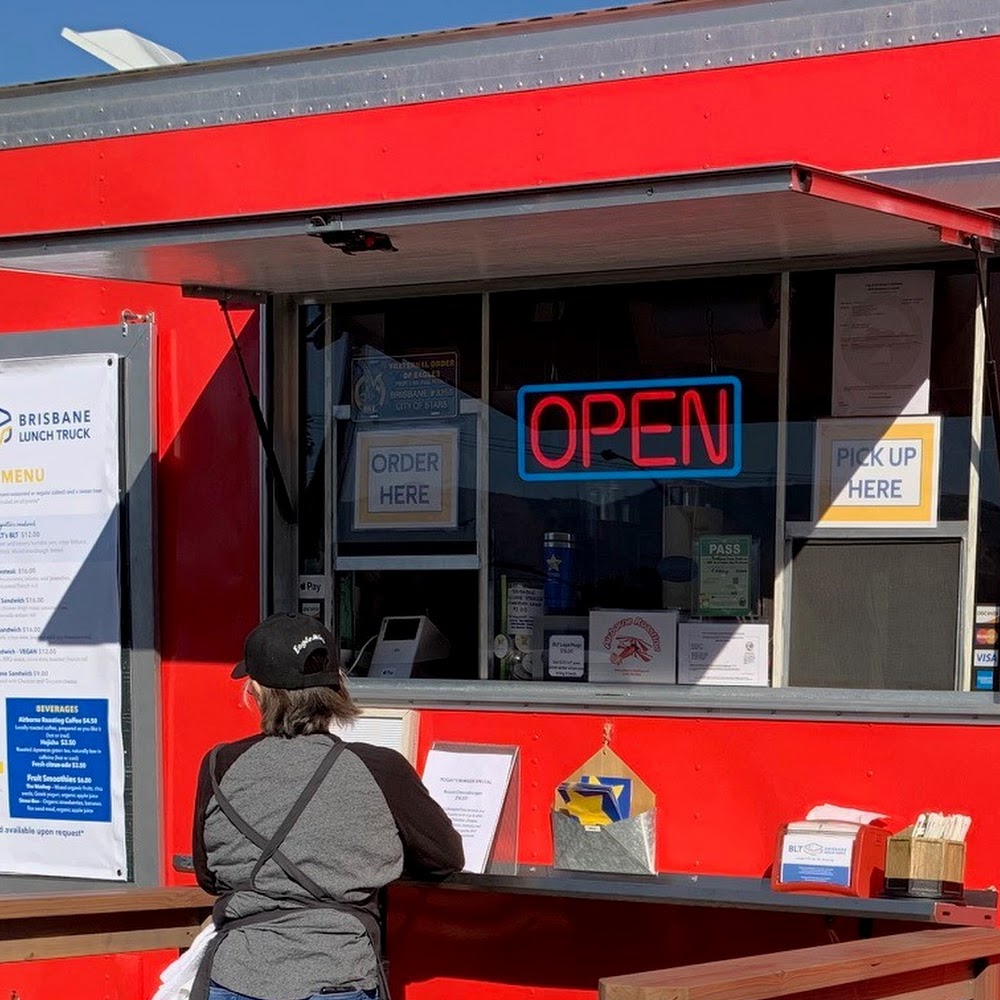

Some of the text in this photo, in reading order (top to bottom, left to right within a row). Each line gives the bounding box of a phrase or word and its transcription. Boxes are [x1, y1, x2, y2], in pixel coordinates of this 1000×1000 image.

[396, 402, 411, 410] CITY
[424, 400, 448, 409] STARS
[19, 409, 91, 426] BRISBANE
[530, 387, 728, 470] OPEN
[19, 428, 91, 443] LUNCH TRUCK
[370, 451, 439, 475] ORDER
[836, 445, 917, 468] PICK UP
[1, 468, 45, 484] MENU
[379, 484, 431, 506] HERE
[848, 478, 903, 500] HERE
[709, 544, 741, 555] PASS
[307, 582, 322, 593] Pay
[976, 653, 997, 662] VISA
[36, 704, 79, 713] BEVERAGES
[26, 774, 42, 782] Fruit
[42, 774, 77, 783] Smoothies
[4, 826, 36, 834] available
[36, 828, 54, 836] upon
[788, 844, 803, 853] BLT
